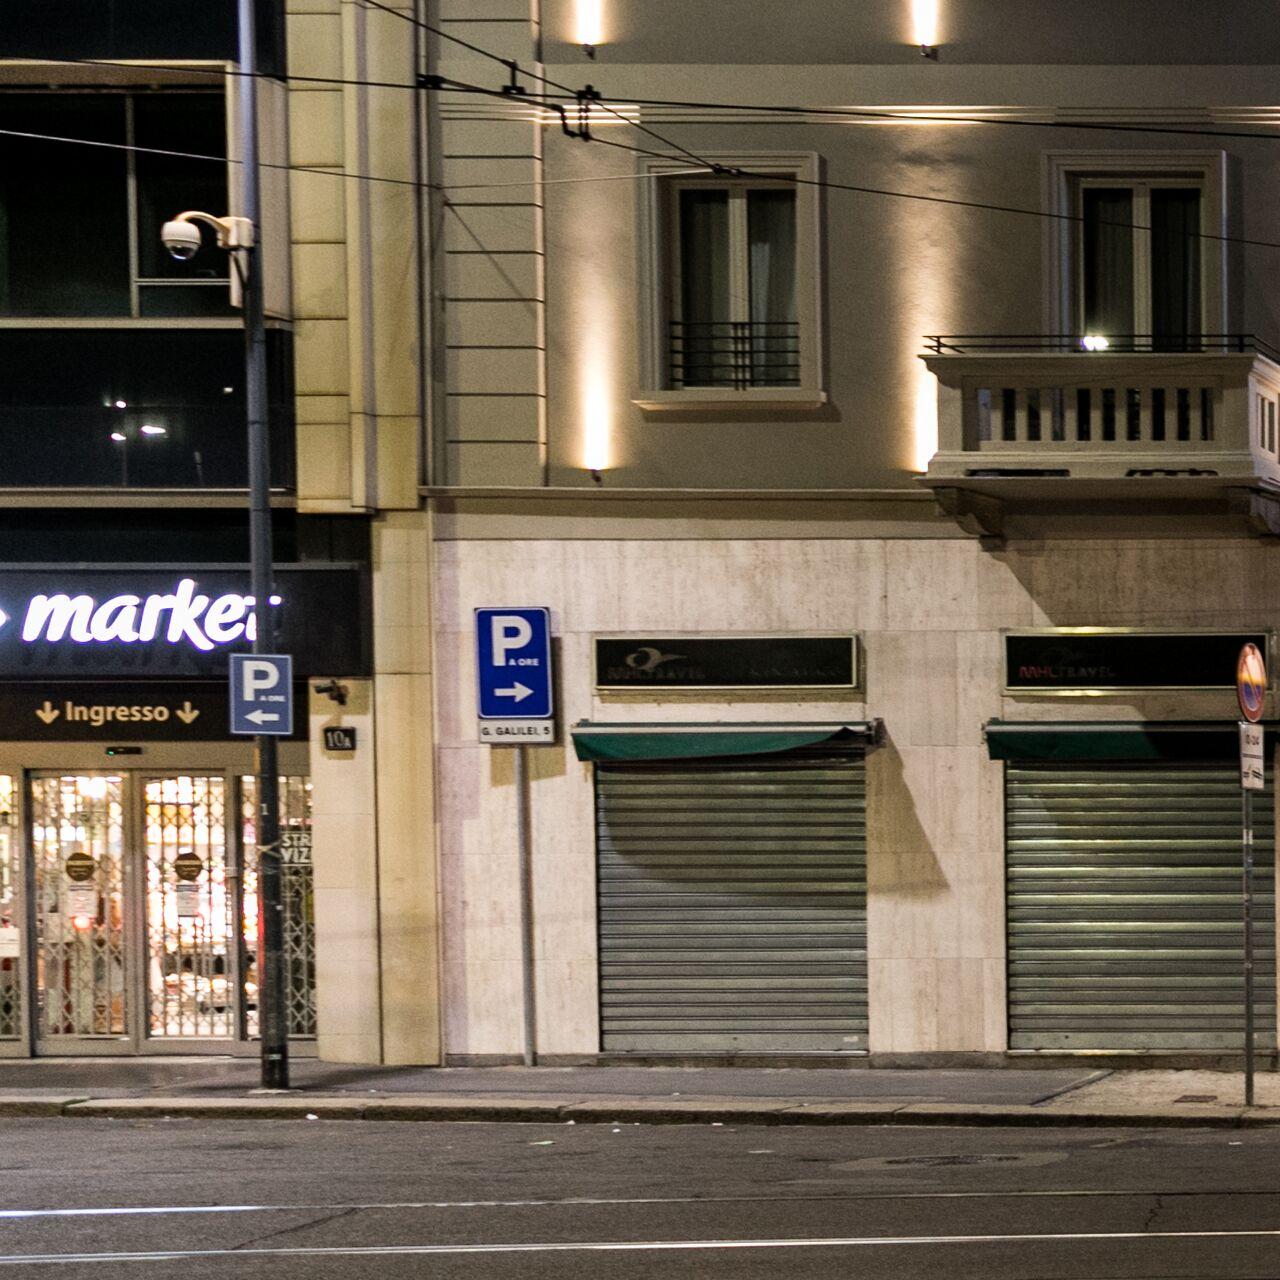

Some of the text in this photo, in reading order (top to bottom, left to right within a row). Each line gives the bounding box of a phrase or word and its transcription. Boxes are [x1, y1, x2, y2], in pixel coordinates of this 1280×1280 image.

[491, 615, 540, 667] P A ORE
[243, 660, 280, 701] P
[65, 701, 170, 726] Ingresso
